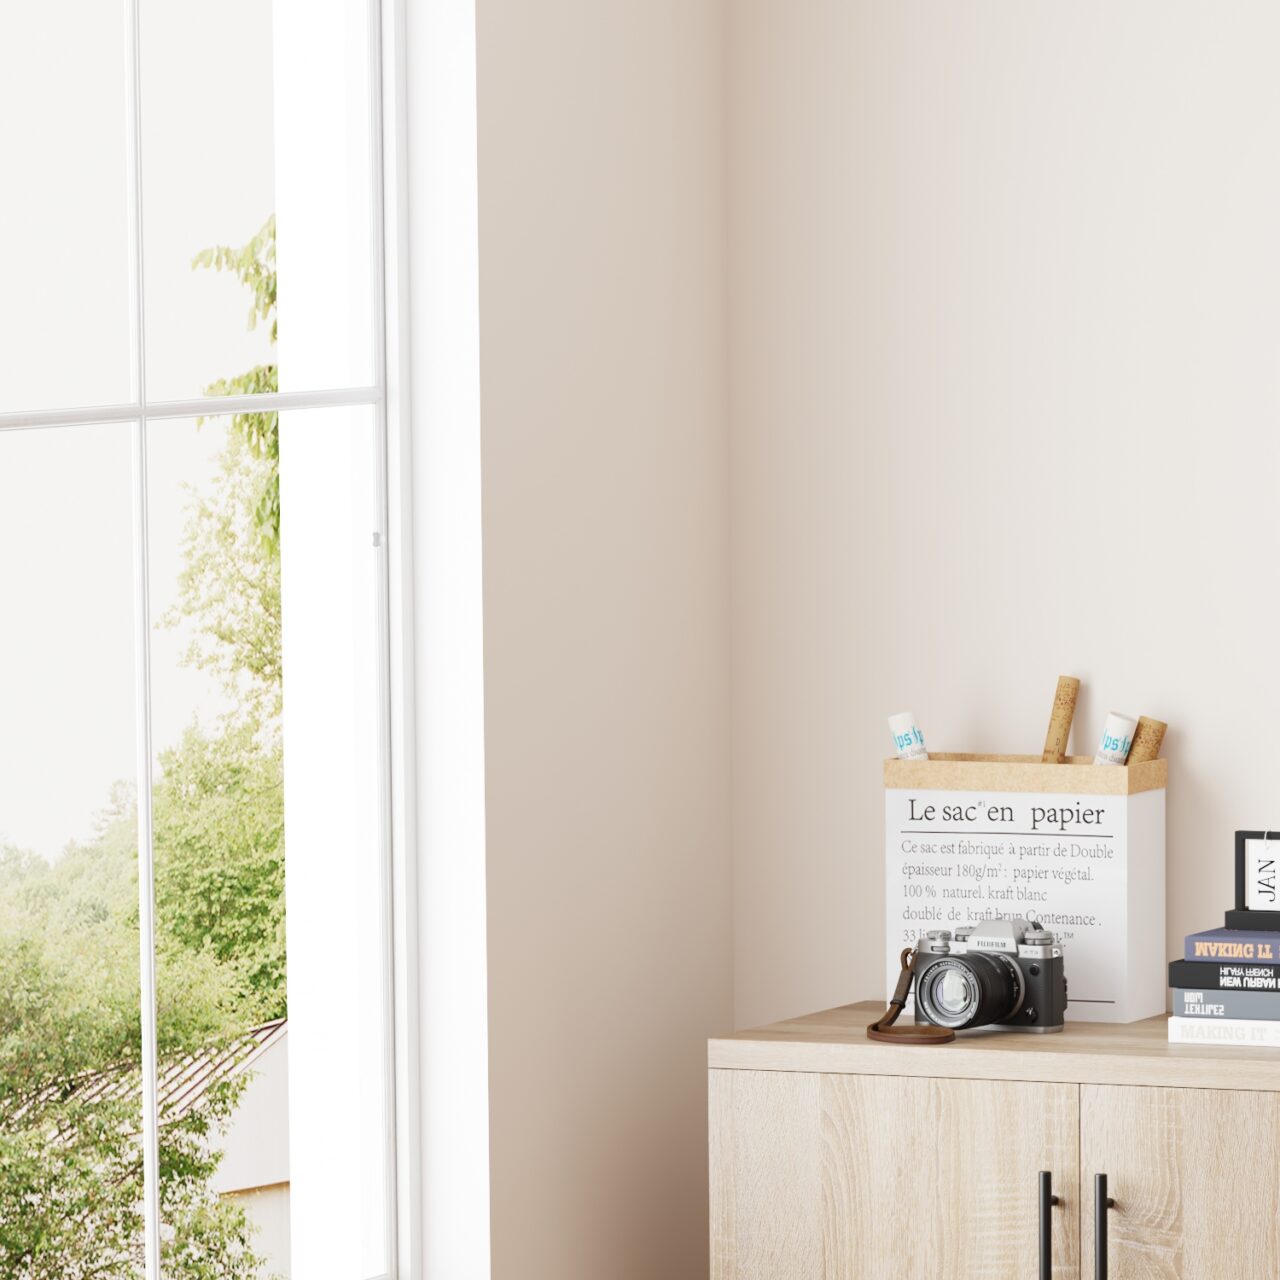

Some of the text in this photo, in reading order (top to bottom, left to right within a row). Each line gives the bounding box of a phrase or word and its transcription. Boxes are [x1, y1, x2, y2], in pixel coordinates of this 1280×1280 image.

[909, 799, 936, 821] Le
[987, 806, 1014, 822] en
[1031, 802, 1104, 831] papier
[902, 840, 918, 854] Ce
[920, 844, 938, 854] sac
[940, 843, 955, 854] est
[958, 840, 1004, 860] fabriqué
[1019, 843, 1050, 860] partir
[1053, 843, 1068, 858] de
[1070, 844, 1114, 859] Double
[902, 862, 953, 879] épaisseur
[1013, 865, 1049, 883] papier
[1052, 867, 1095, 885] végétal.
[1258, 859, 1275, 902] JAN
[904, 884, 922, 898] 100
[988, 885, 1014, 899] kraft
[1017, 887, 1047, 901] blanc
[903, 906, 942, 920] doublé
[947, 907, 961, 920] de
[967, 907, 993, 920] kraft
[904, 929, 916, 942] 33
[1180, 1024, 1245, 1041] MAKING
[1251, 1027, 1267, 1041] IT
